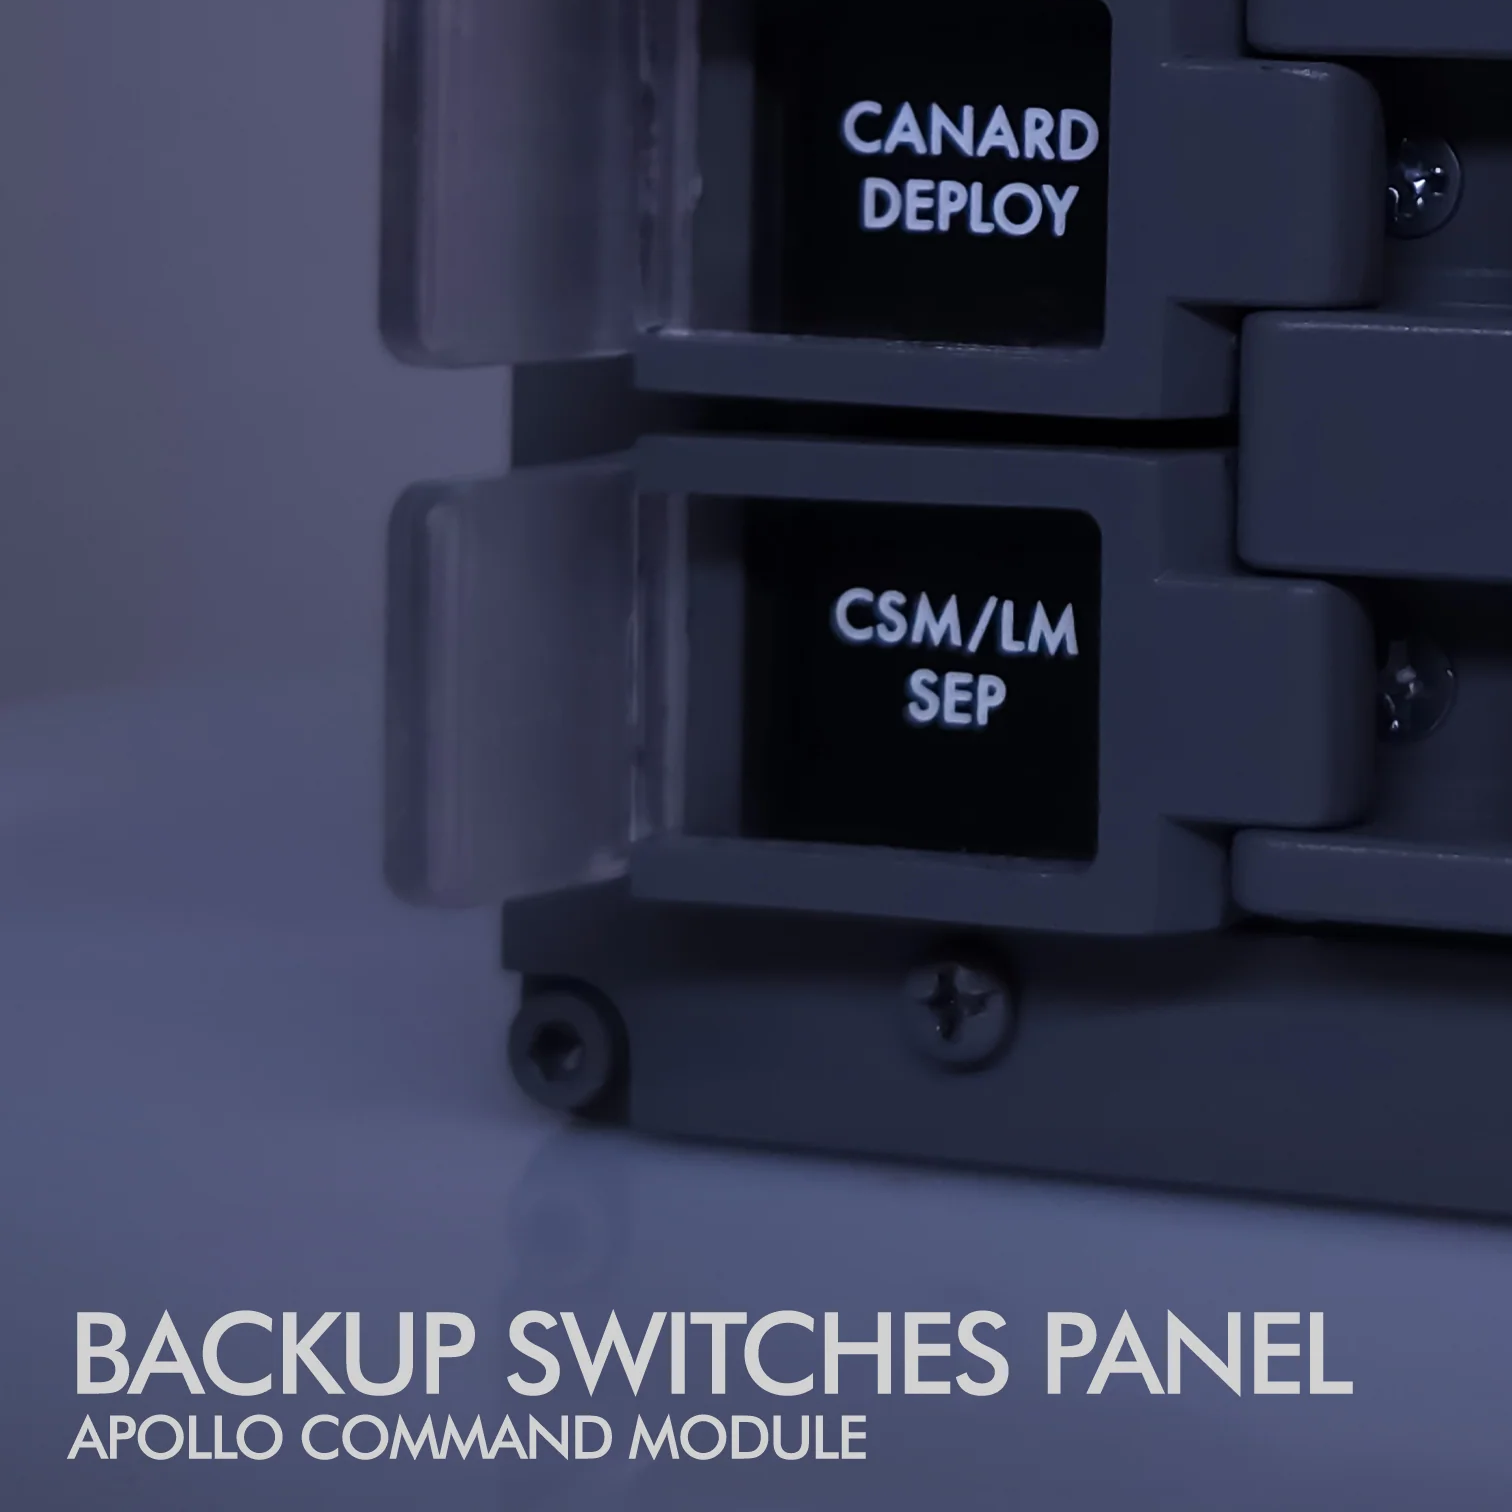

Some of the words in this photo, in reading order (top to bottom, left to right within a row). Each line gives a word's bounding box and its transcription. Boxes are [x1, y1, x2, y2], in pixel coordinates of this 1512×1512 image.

[843, 100, 1099, 161] CANARD
[863, 177, 1080, 237] DEPLOY
[835, 587, 1079, 656] CSM/LM
[908, 668, 1007, 726] SEP
